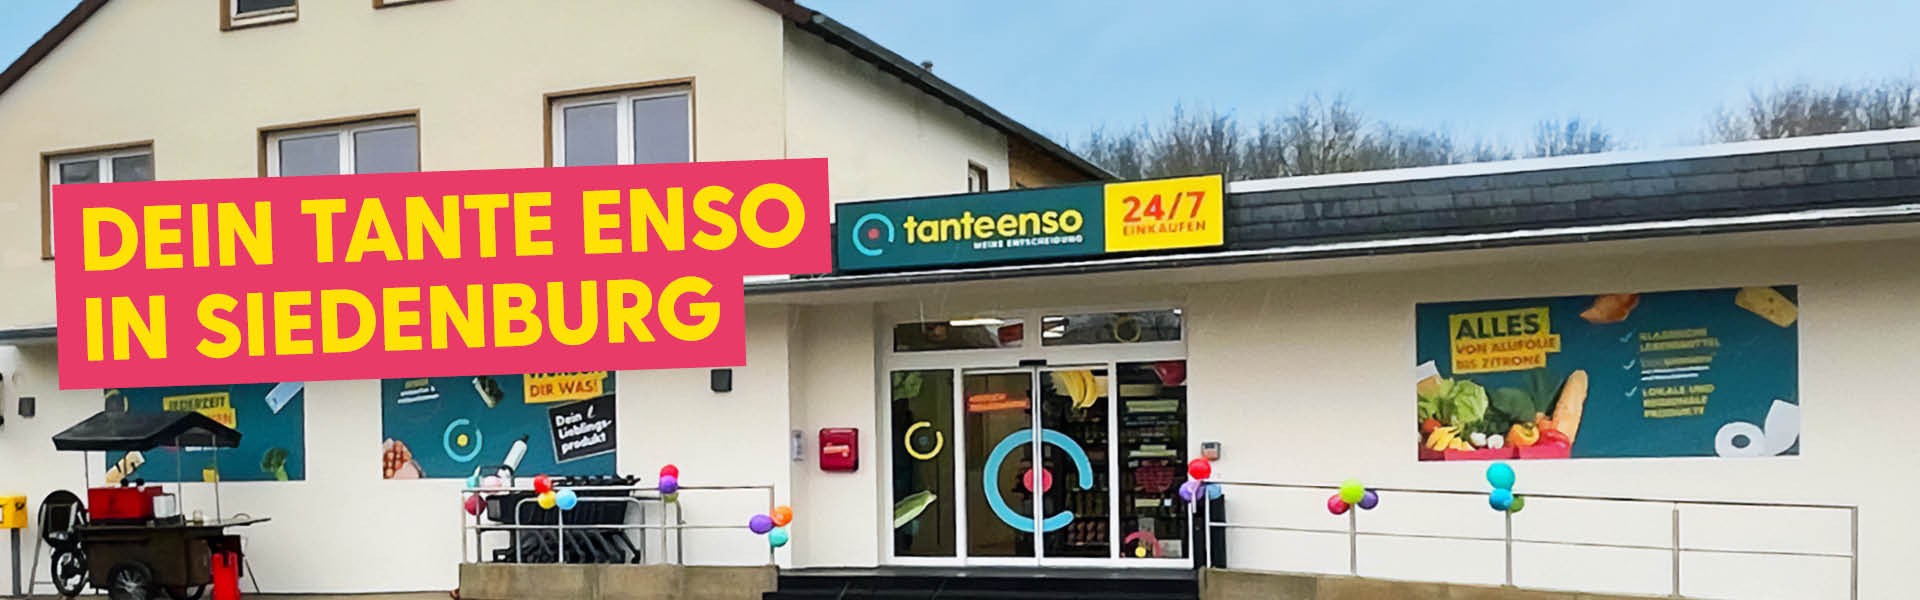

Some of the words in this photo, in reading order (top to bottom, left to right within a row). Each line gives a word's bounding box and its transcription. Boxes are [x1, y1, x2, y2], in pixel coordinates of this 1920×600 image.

[1122, 191, 1206, 223] 24/7
[903, 209, 1083, 244] tanteenso
[1122, 220, 1206, 237] EINKAUFEN
[1456, 313, 1539, 340] ALLES
[1456, 343, 1487, 354] VON
[530, 383, 553, 398] DIR
[558, 379, 598, 395] WAS!
[555, 411, 583, 427] Dein
[561, 432, 606, 455] produkt
